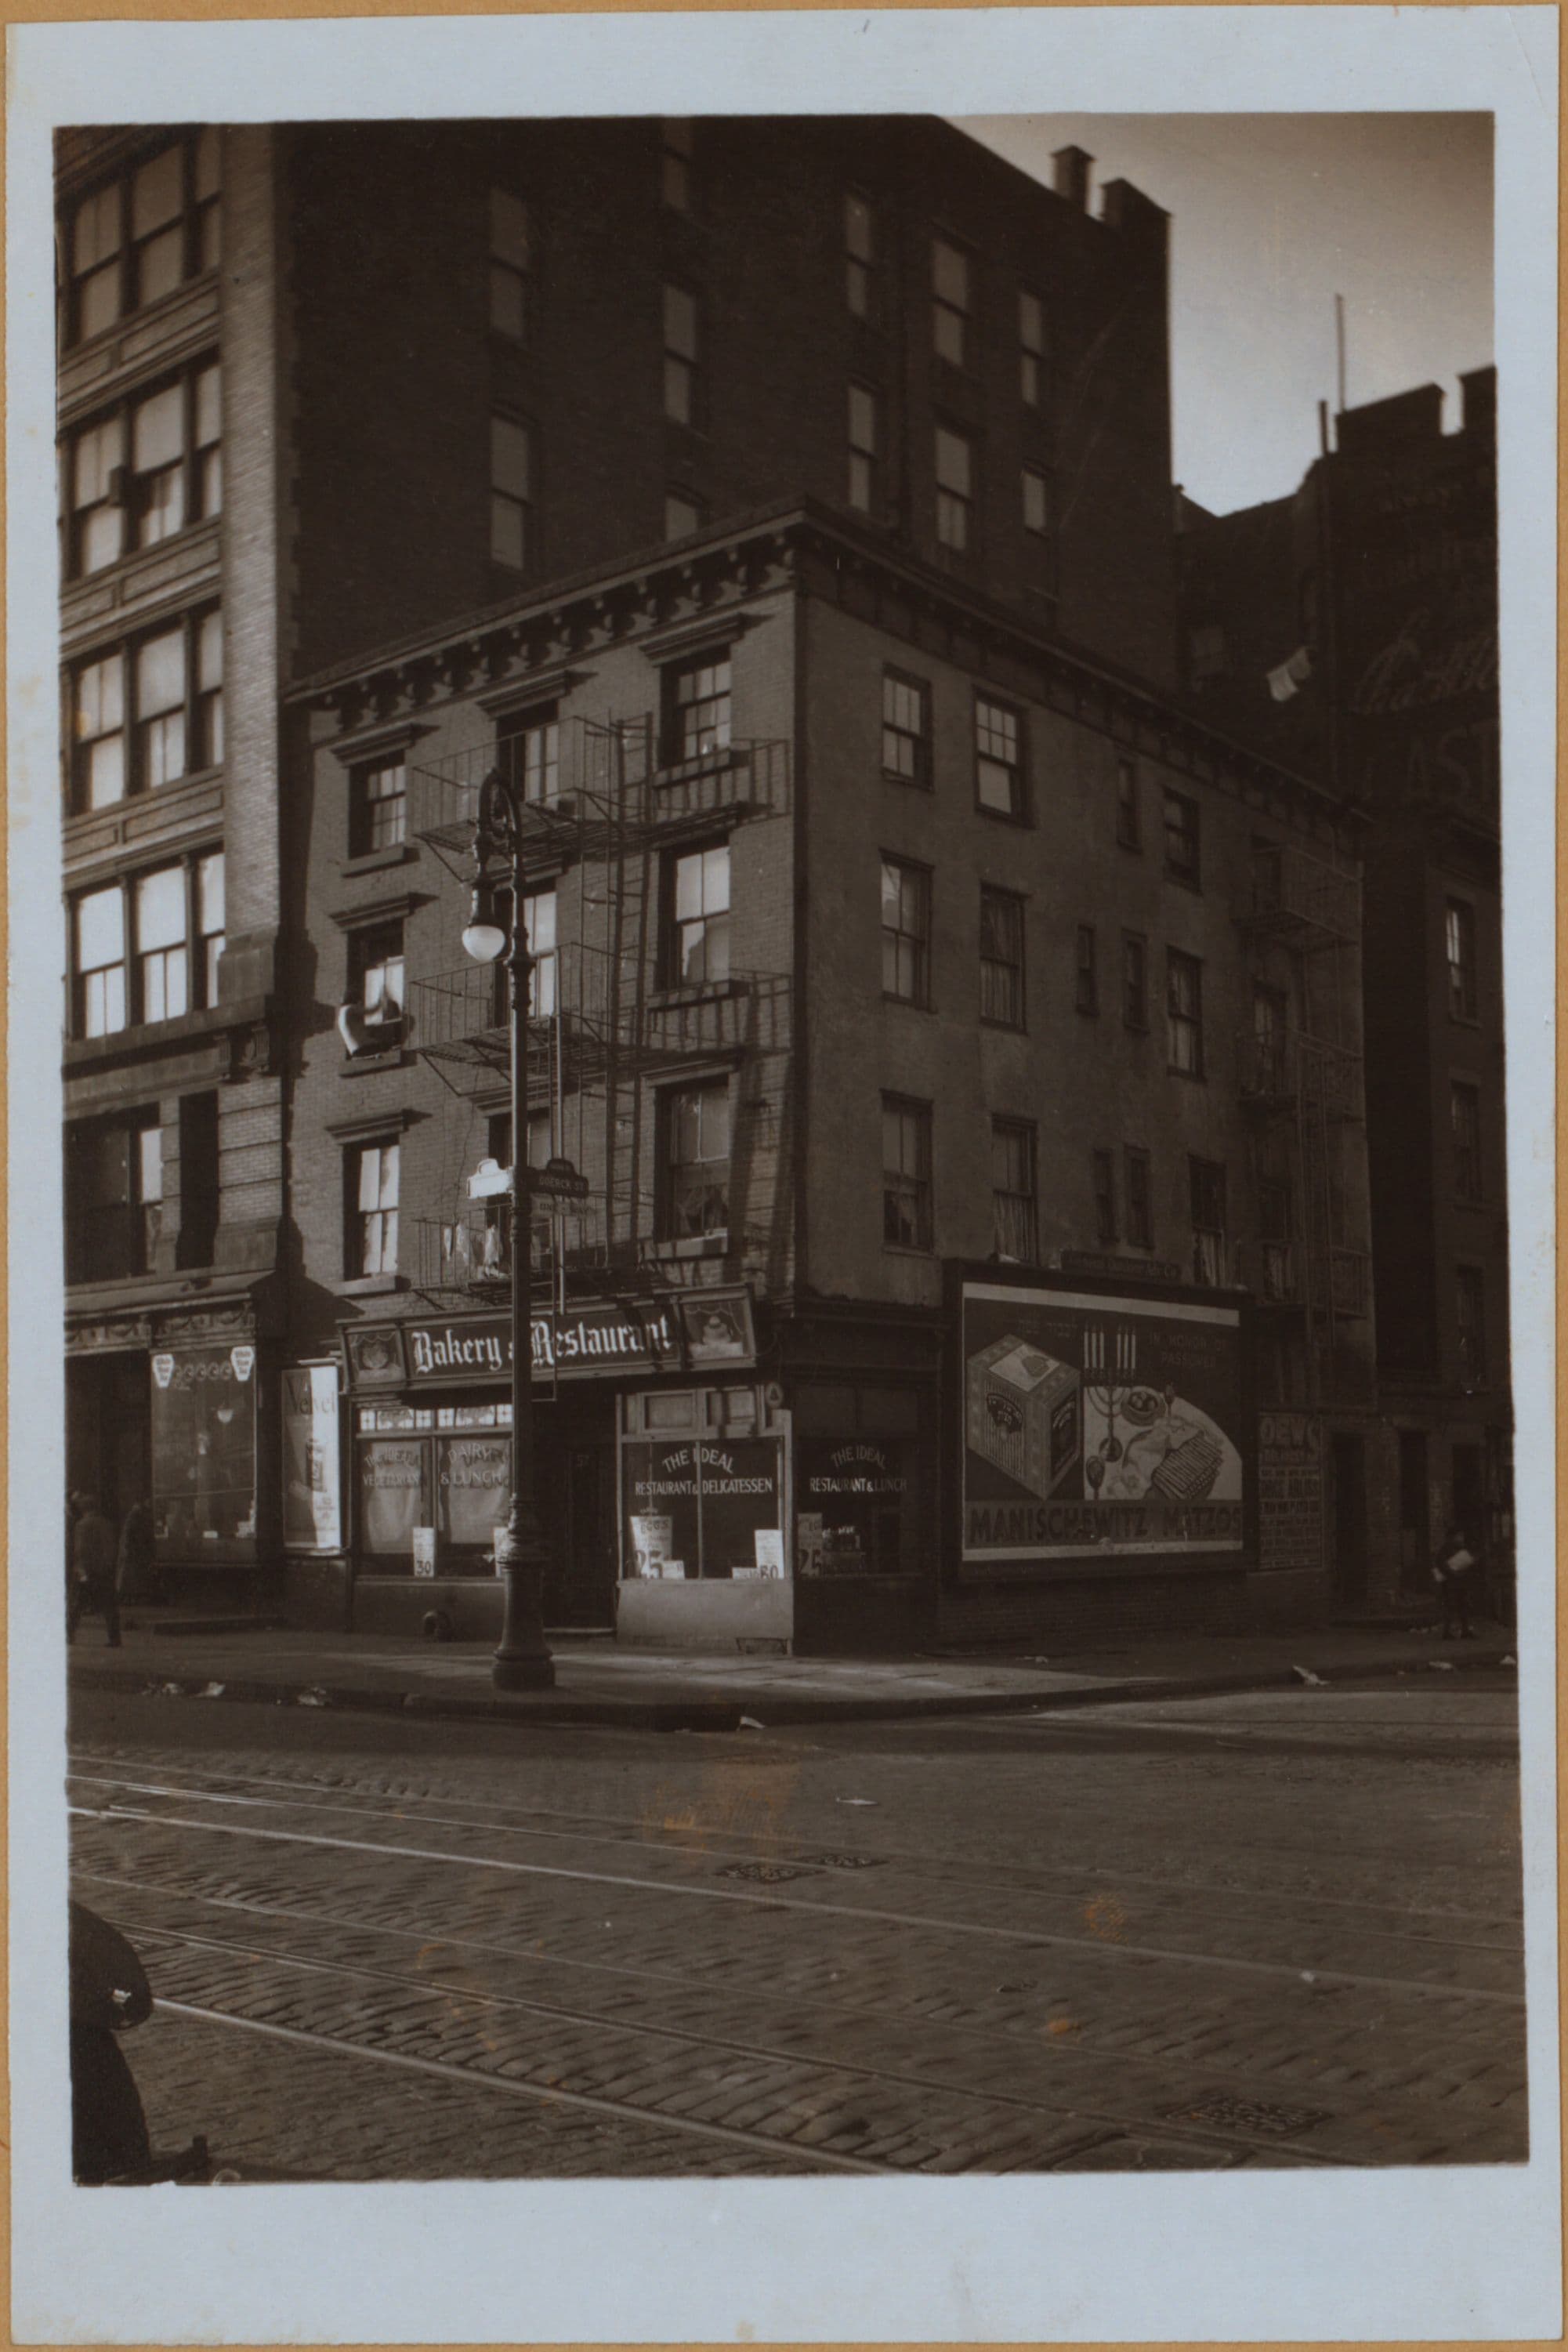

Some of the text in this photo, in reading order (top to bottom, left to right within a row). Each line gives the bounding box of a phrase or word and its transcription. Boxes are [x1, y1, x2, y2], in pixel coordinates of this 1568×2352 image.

[574, 1181, 585, 1192] ST
[411, 1328, 503, 1374] Bakery
[531, 1314, 672, 1366] Restaurant
[447, 1443, 492, 1465] DAIRY
[662, 1448, 733, 1474] THE IDEAL
[831, 1444, 885, 1470] THE IDEAL
[440, 1470, 502, 1485] & LUNCH
[635, 1480, 693, 1495] RESTAURANT
[702, 1477, 773, 1495] DELICATESSEN
[809, 1477, 907, 1492] RESTAURANT & LUNCH
[971, 1506, 1241, 1542] MANISCHEWITZ MATZOS
[416, 1560, 431, 1575] 30
